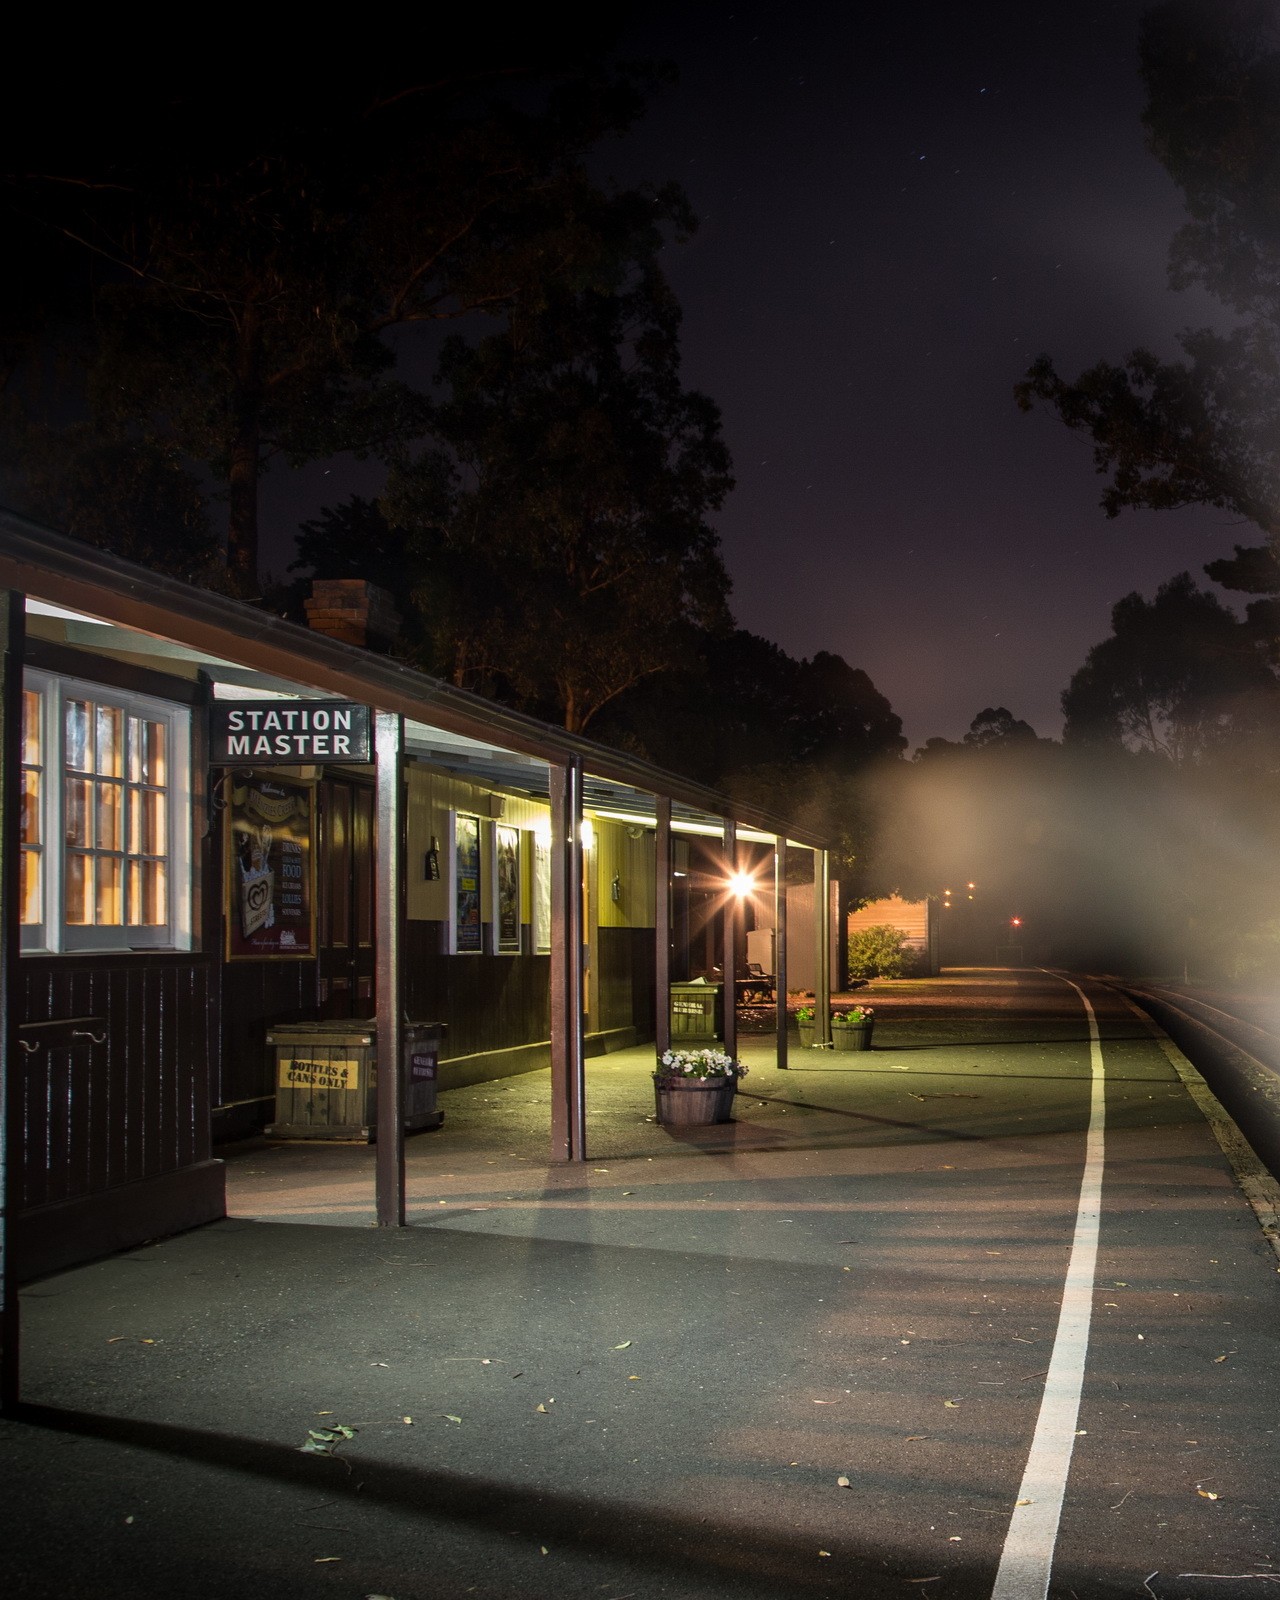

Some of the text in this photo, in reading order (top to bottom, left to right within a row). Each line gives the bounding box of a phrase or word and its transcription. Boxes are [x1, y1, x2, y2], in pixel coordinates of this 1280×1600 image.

[228, 710, 351, 731] STATION
[227, 735, 350, 755] MASTER
[283, 842, 301, 853] DRINKS
[283, 864, 302, 878] FOOD
[290, 1060, 349, 1078] BOTTLES &
[288, 1071, 347, 1089] CANS ONLY
